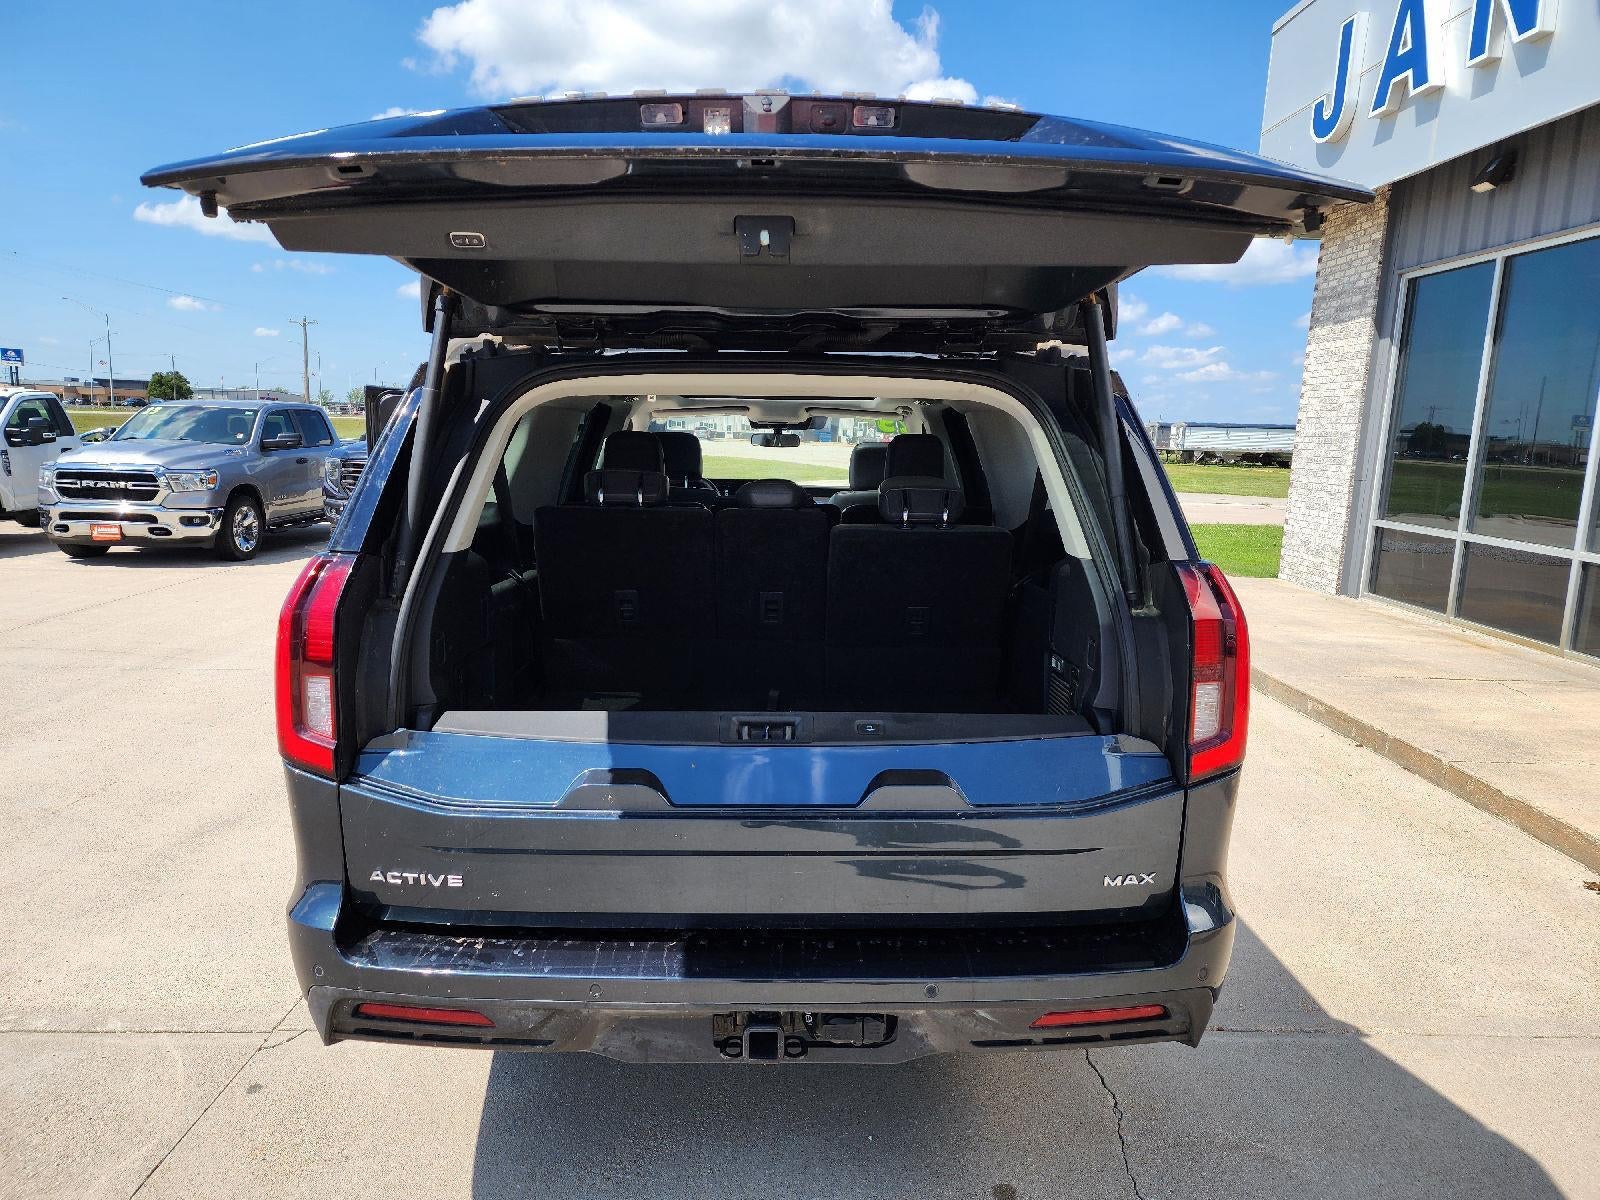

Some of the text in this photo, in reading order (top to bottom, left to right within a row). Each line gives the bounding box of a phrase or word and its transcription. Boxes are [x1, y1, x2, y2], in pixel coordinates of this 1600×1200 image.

[81, 480, 129, 489] RAM
[369, 870, 464, 887] ACTIVE
[1103, 872, 1157, 887] MAX
